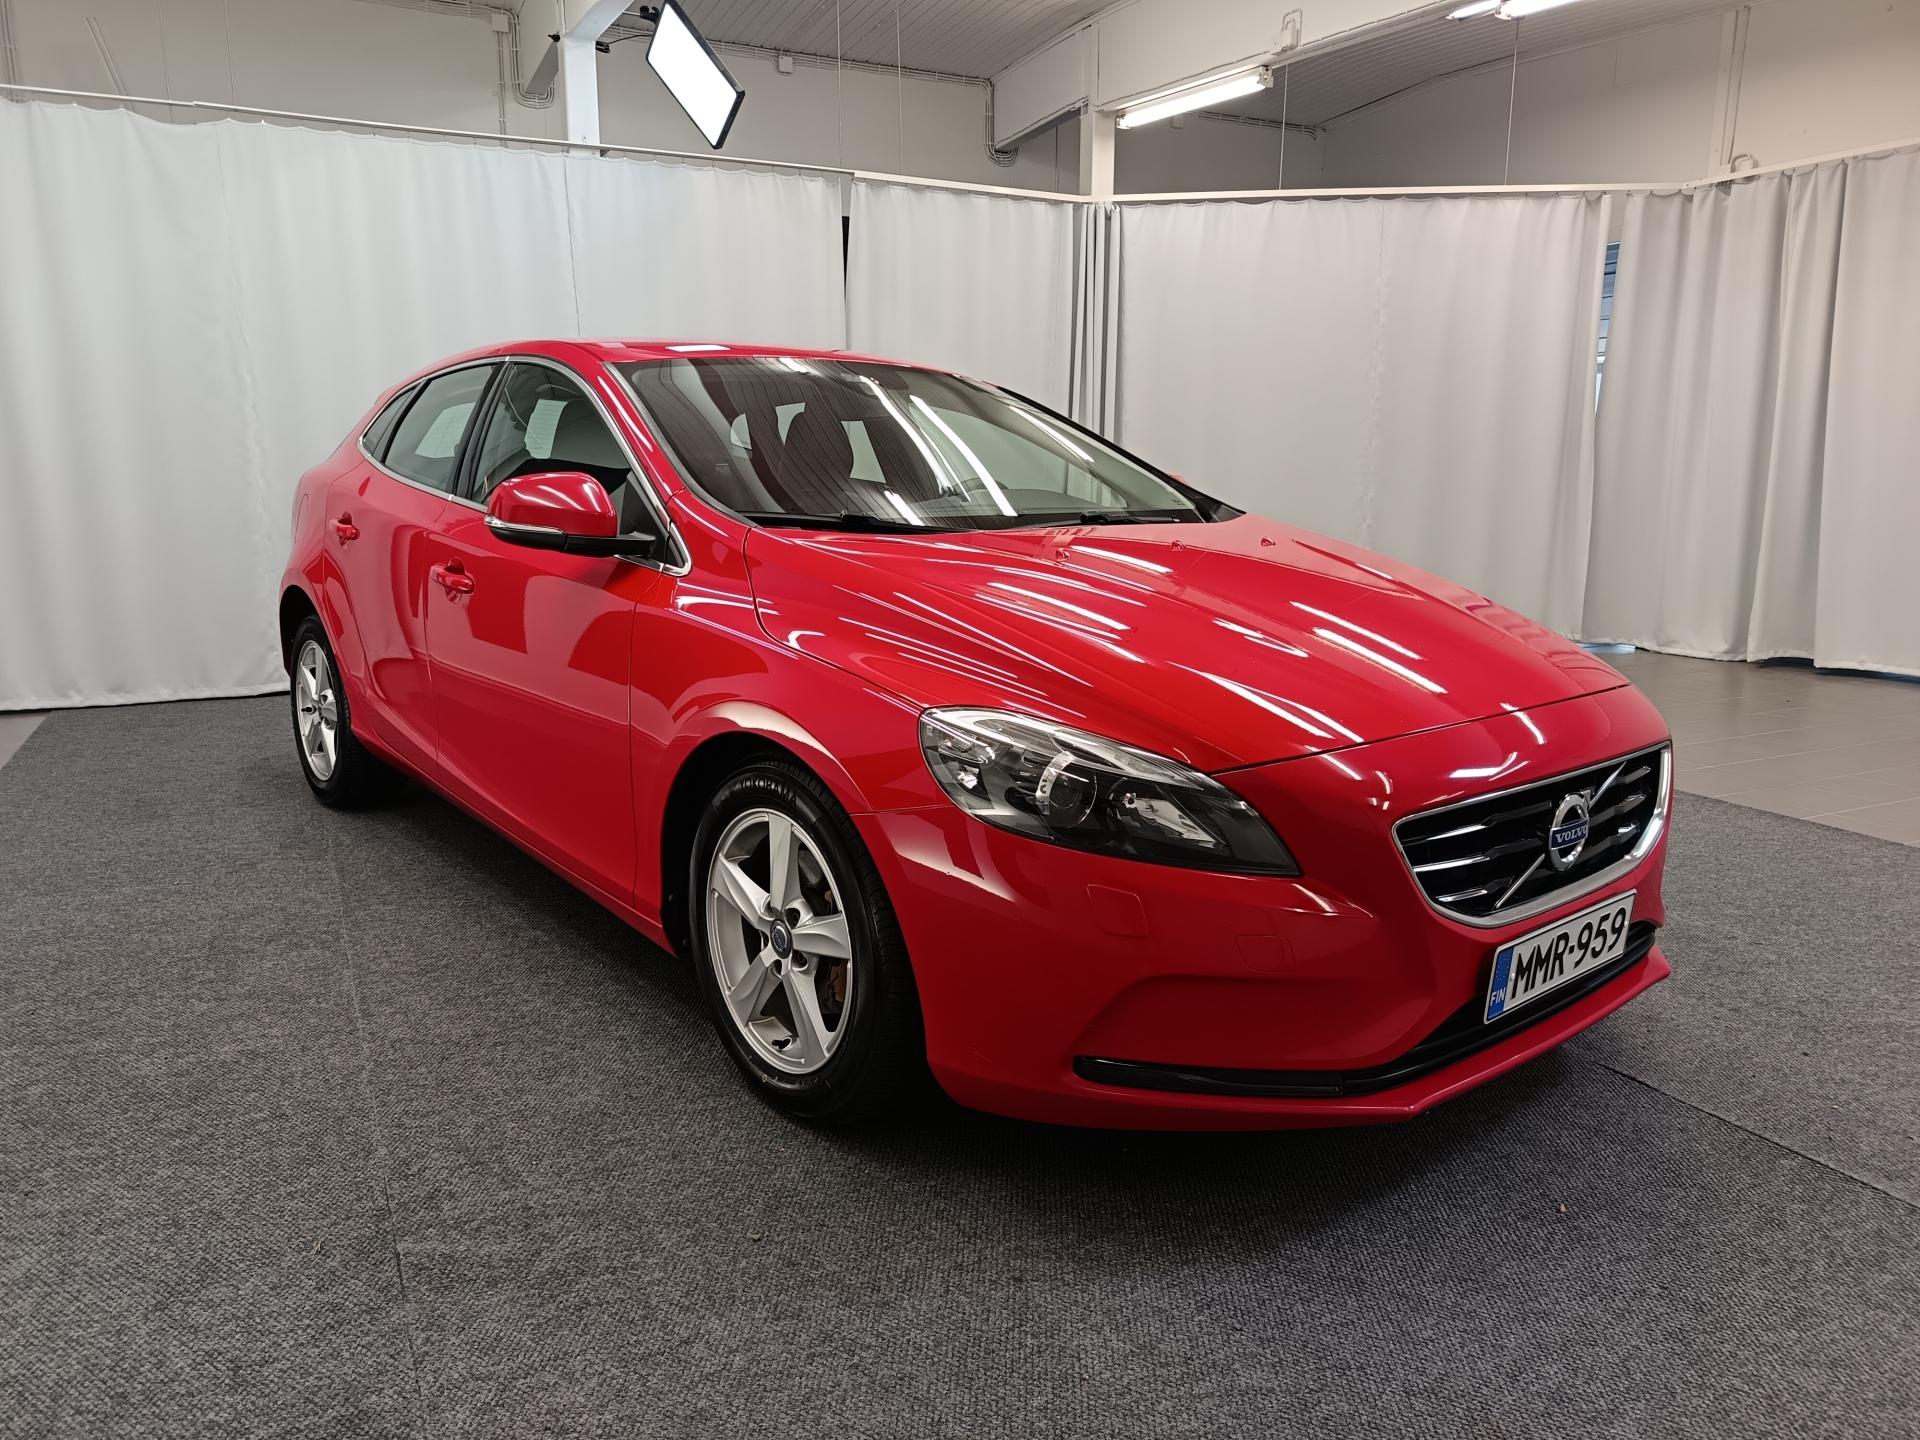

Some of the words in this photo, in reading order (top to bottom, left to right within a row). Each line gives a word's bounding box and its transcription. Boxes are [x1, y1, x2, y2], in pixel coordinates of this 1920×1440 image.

[1555, 825, 1588, 843] VOLVO
[1511, 907, 1626, 999] MMR-959
[1490, 987, 1506, 1006] FIN
